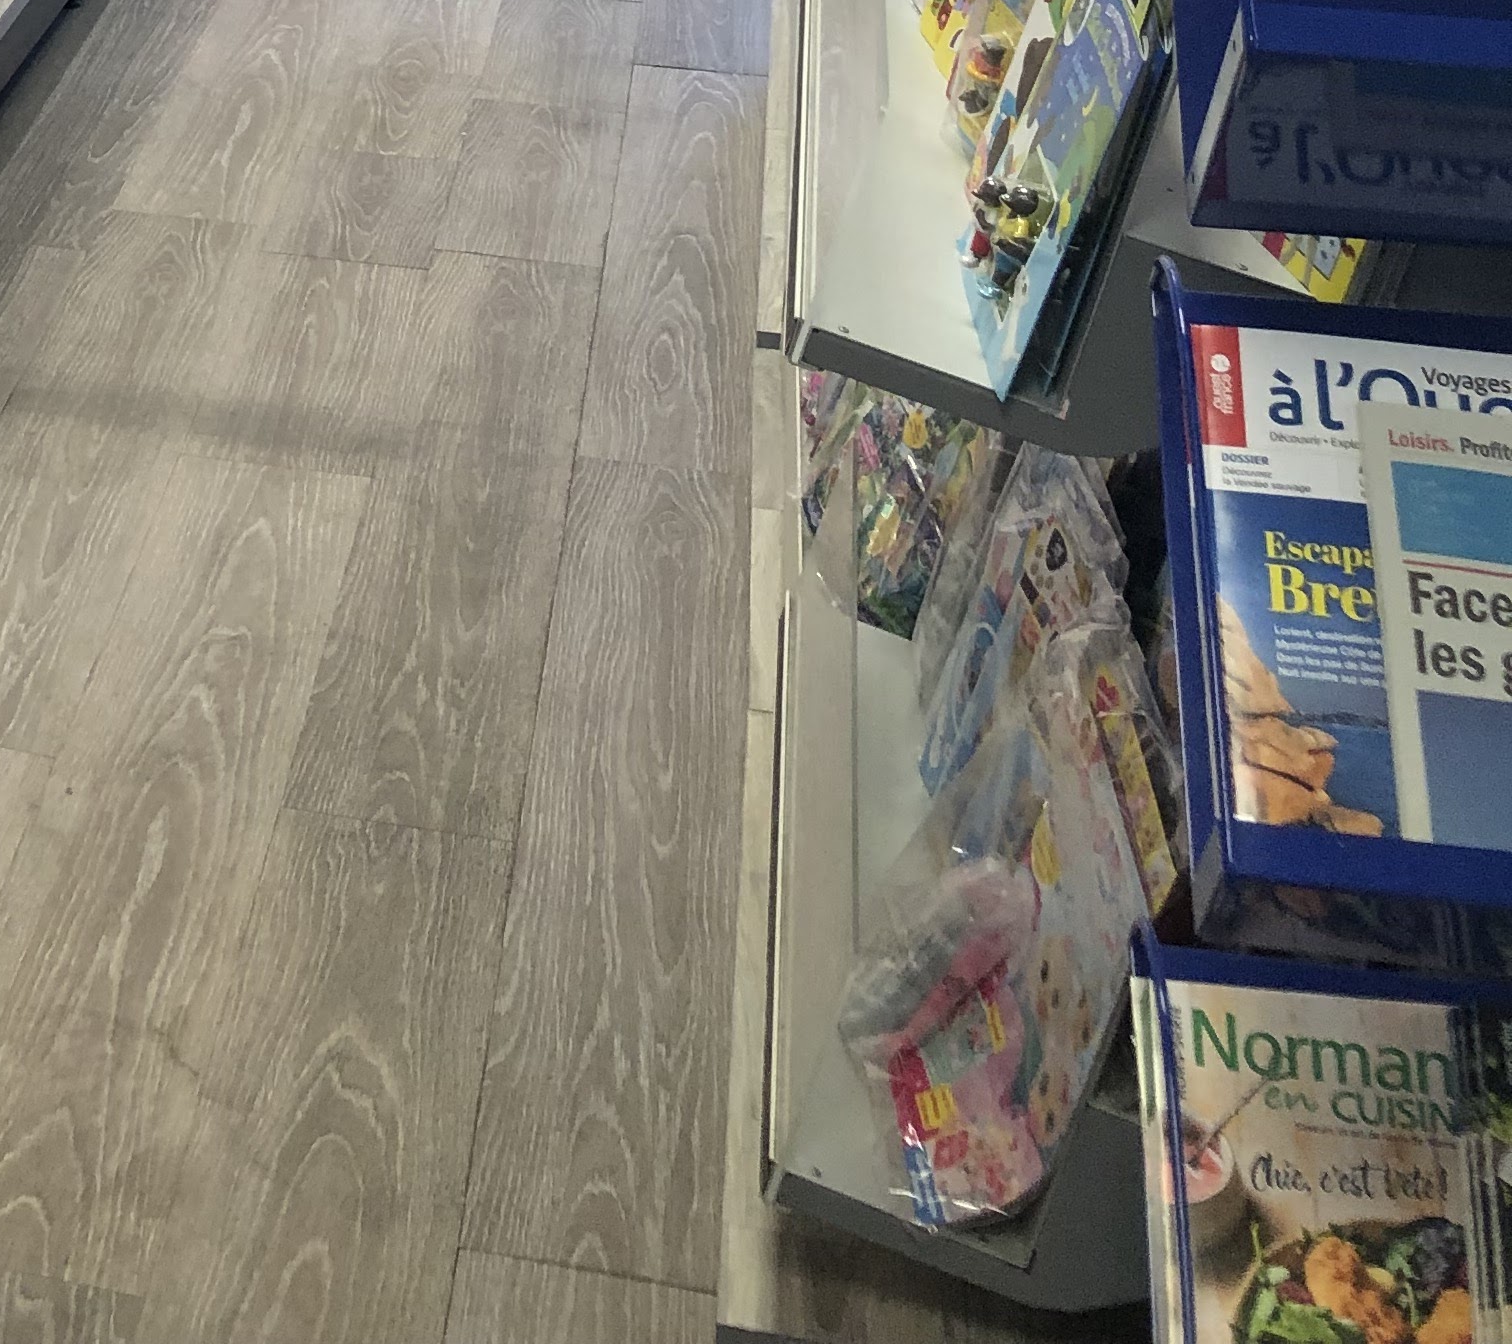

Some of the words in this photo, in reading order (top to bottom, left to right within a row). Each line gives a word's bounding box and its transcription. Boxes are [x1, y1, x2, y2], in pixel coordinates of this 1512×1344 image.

[1268, 369, 1304, 426] à
[1421, 366, 1511, 394] Voyages
[1221, 452, 1269, 466] DOSSIER
[1407, 570, 1512, 628] Face
[1413, 628, 1486, 681] les
[1264, 1085, 1318, 1112] en
